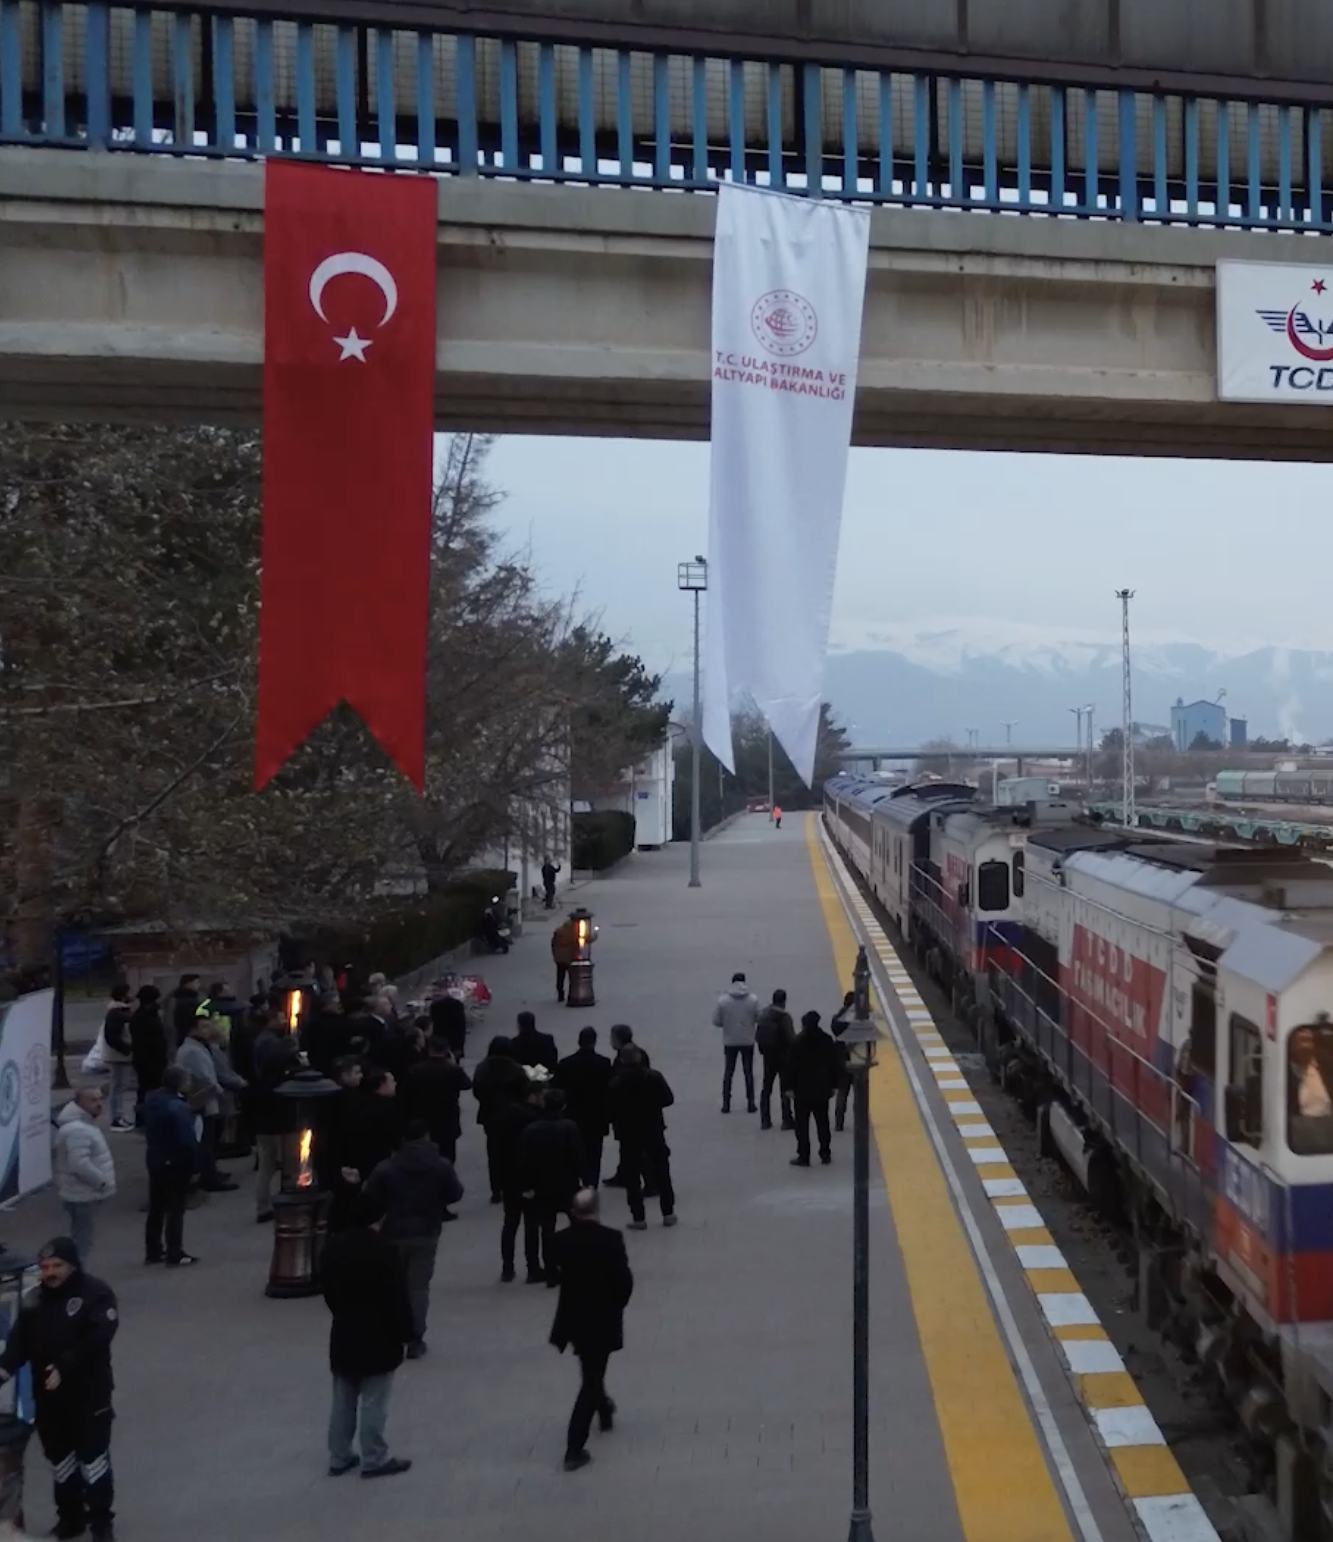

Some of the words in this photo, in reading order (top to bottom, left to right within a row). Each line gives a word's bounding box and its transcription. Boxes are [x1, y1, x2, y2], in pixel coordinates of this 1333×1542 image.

[714, 366, 768, 387] ALTYAPI
[769, 376, 845, 400] BAKANLIĞI
[716, 350, 738, 367] T.C.
[741, 355, 825, 382] ULAŞTIRMA
[828, 370, 847, 386] VE
